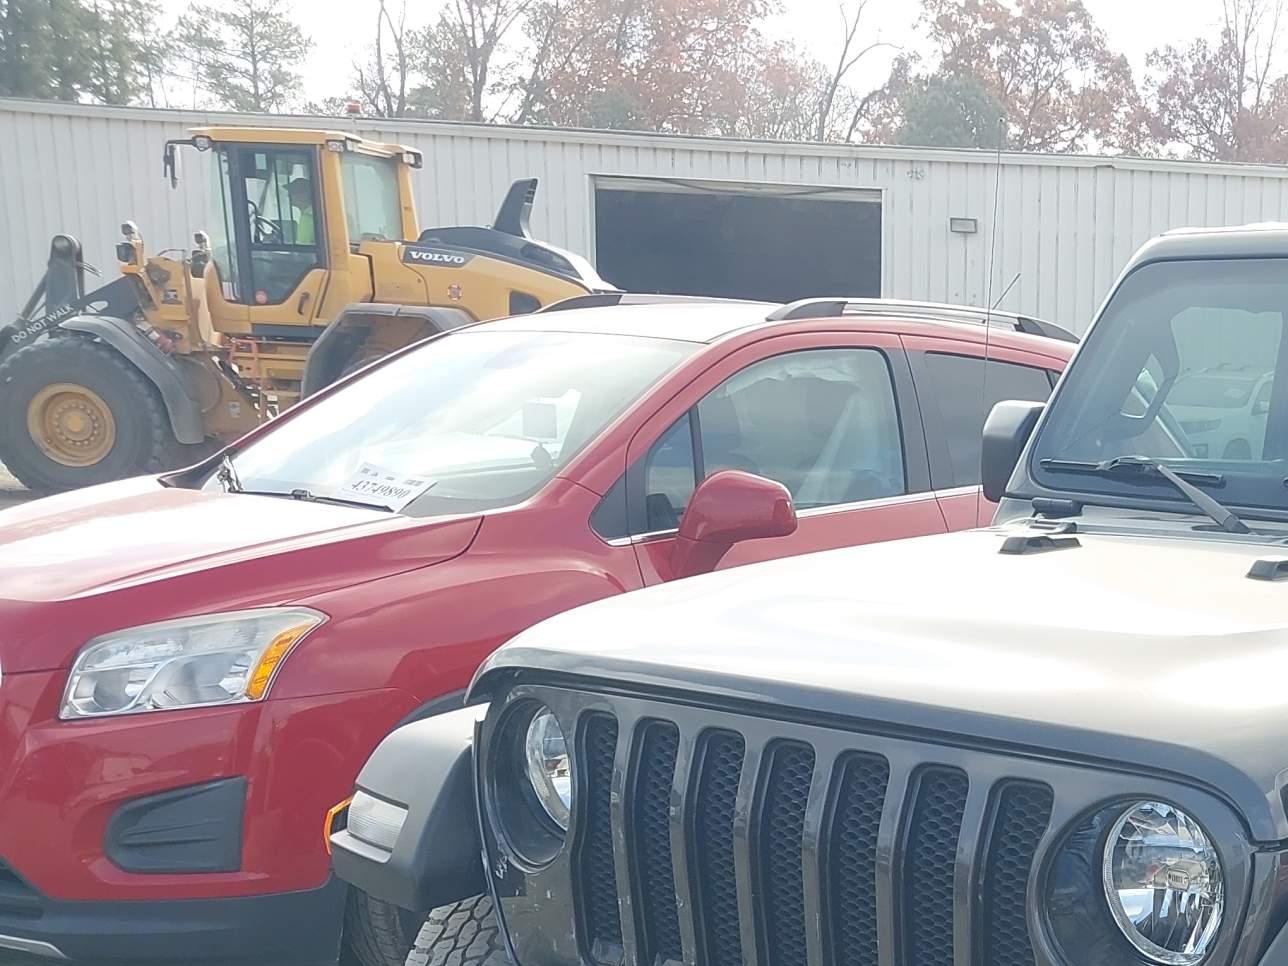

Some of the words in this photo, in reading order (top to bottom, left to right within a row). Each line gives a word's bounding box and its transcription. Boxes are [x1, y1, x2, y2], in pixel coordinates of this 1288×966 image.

[409, 250, 465, 264] VOLVO
[11, 331, 28, 343] DO
[26, 318, 47, 335] NOT
[46, 303, 75, 322] WALK
